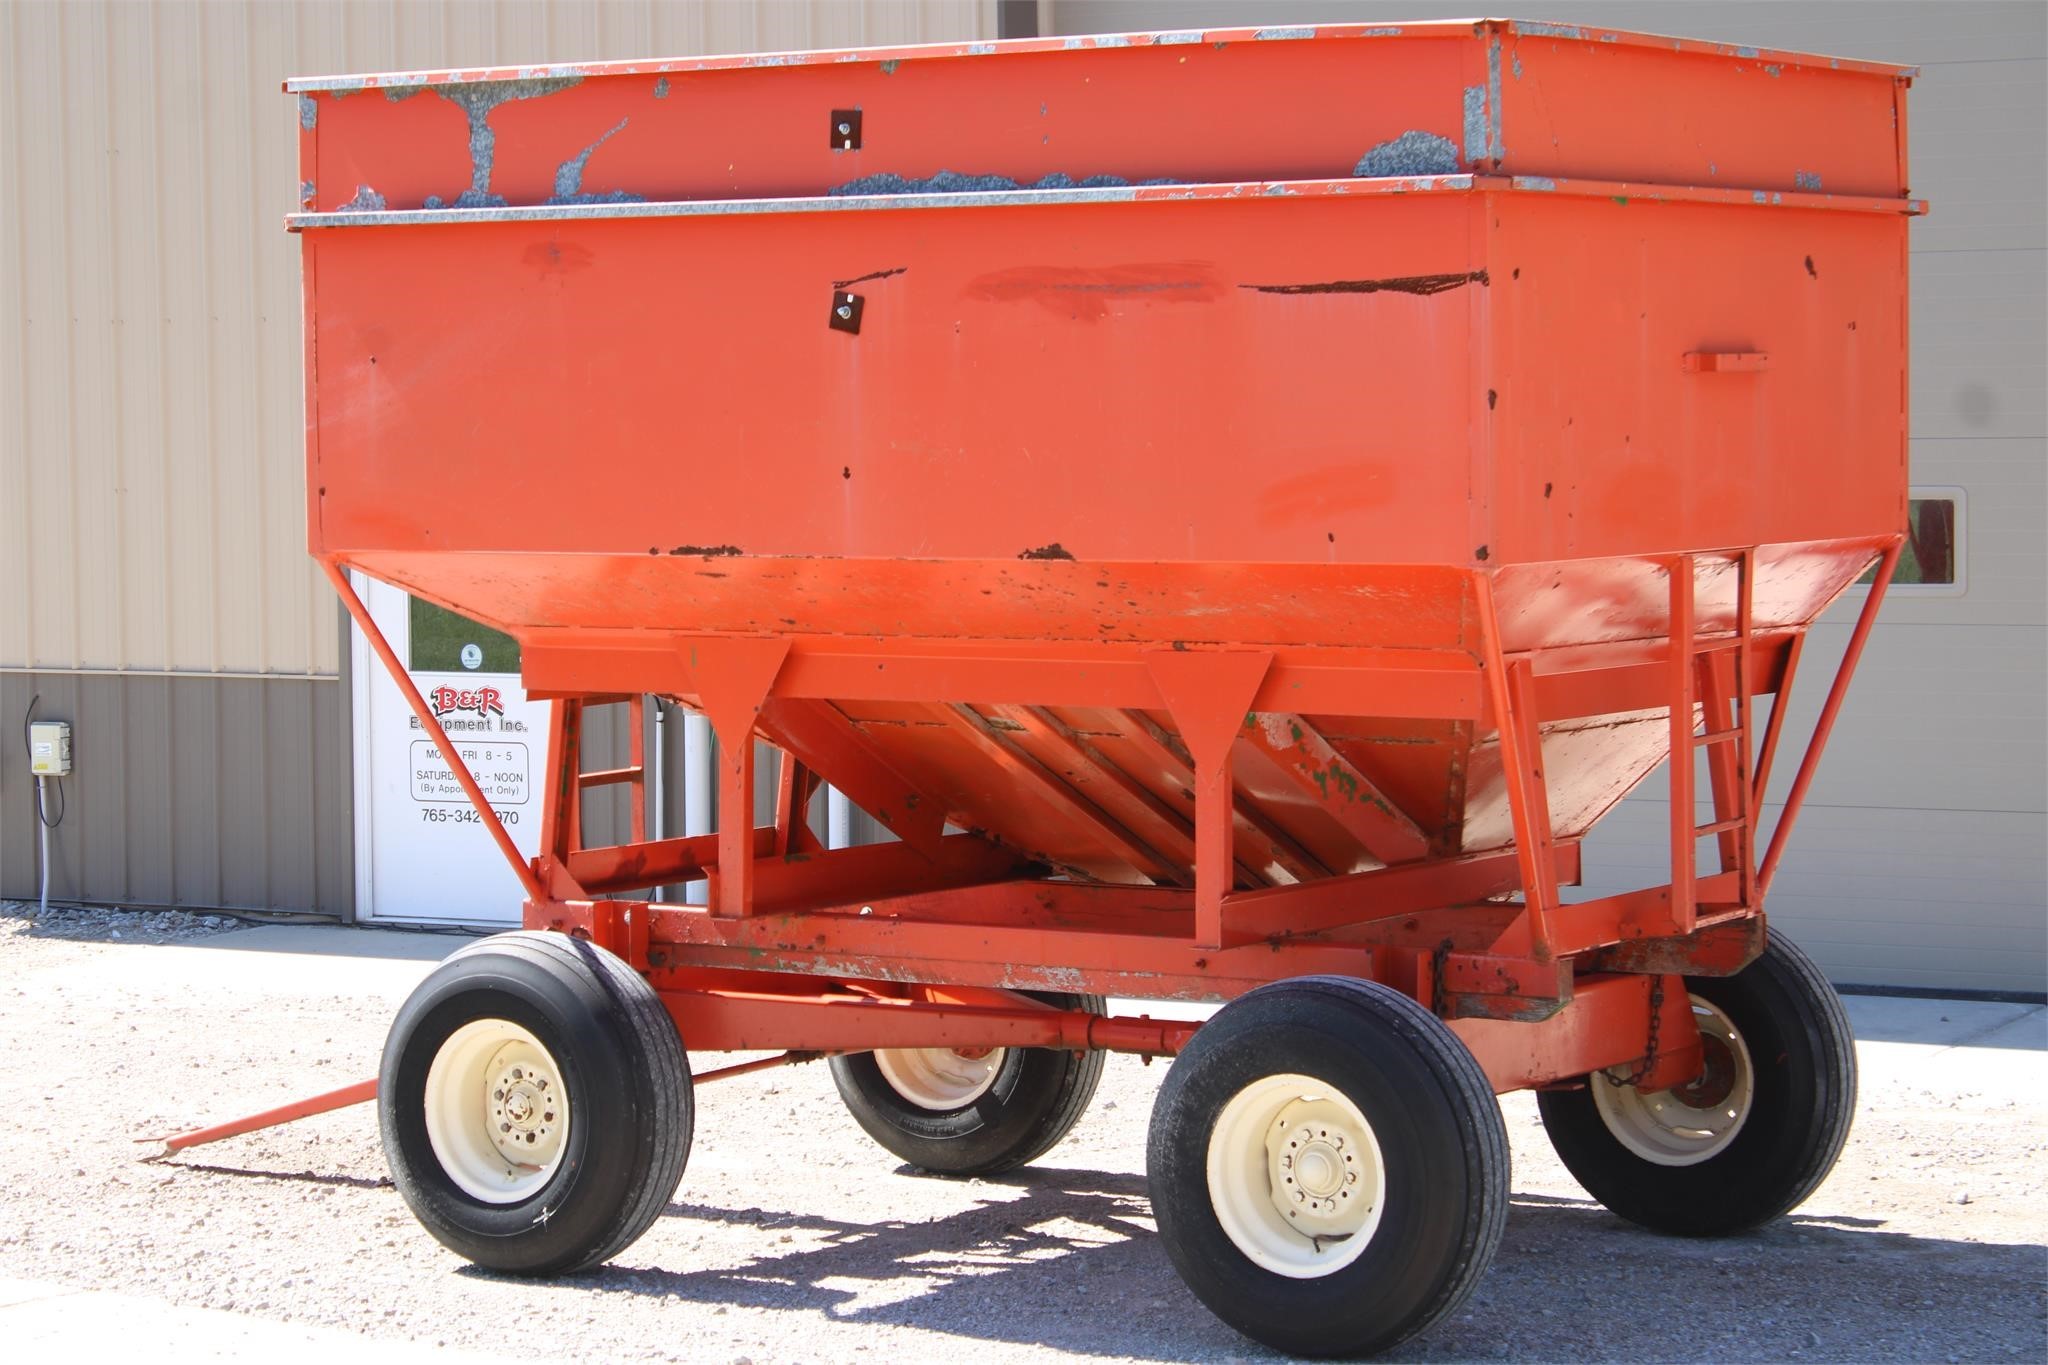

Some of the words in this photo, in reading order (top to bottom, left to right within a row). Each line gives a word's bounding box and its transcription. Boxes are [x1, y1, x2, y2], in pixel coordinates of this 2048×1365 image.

[430, 684, 504, 718] B&R
[410, 716, 491, 732] Eipment
[500, 718, 528, 731] Inc.
[426, 749, 442, 759] MO
[462, 750, 477, 760] FRI
[485, 751, 492, 760] 8
[505, 751, 512, 761] 5
[416, 770, 457, 781] SATURD
[474, 772, 480, 782] 8
[494, 773, 523, 782] NOON
[420, 783, 435, 793] (By
[496, 785, 519, 796] Only)
[422, 808, 519, 824] 765-342970
